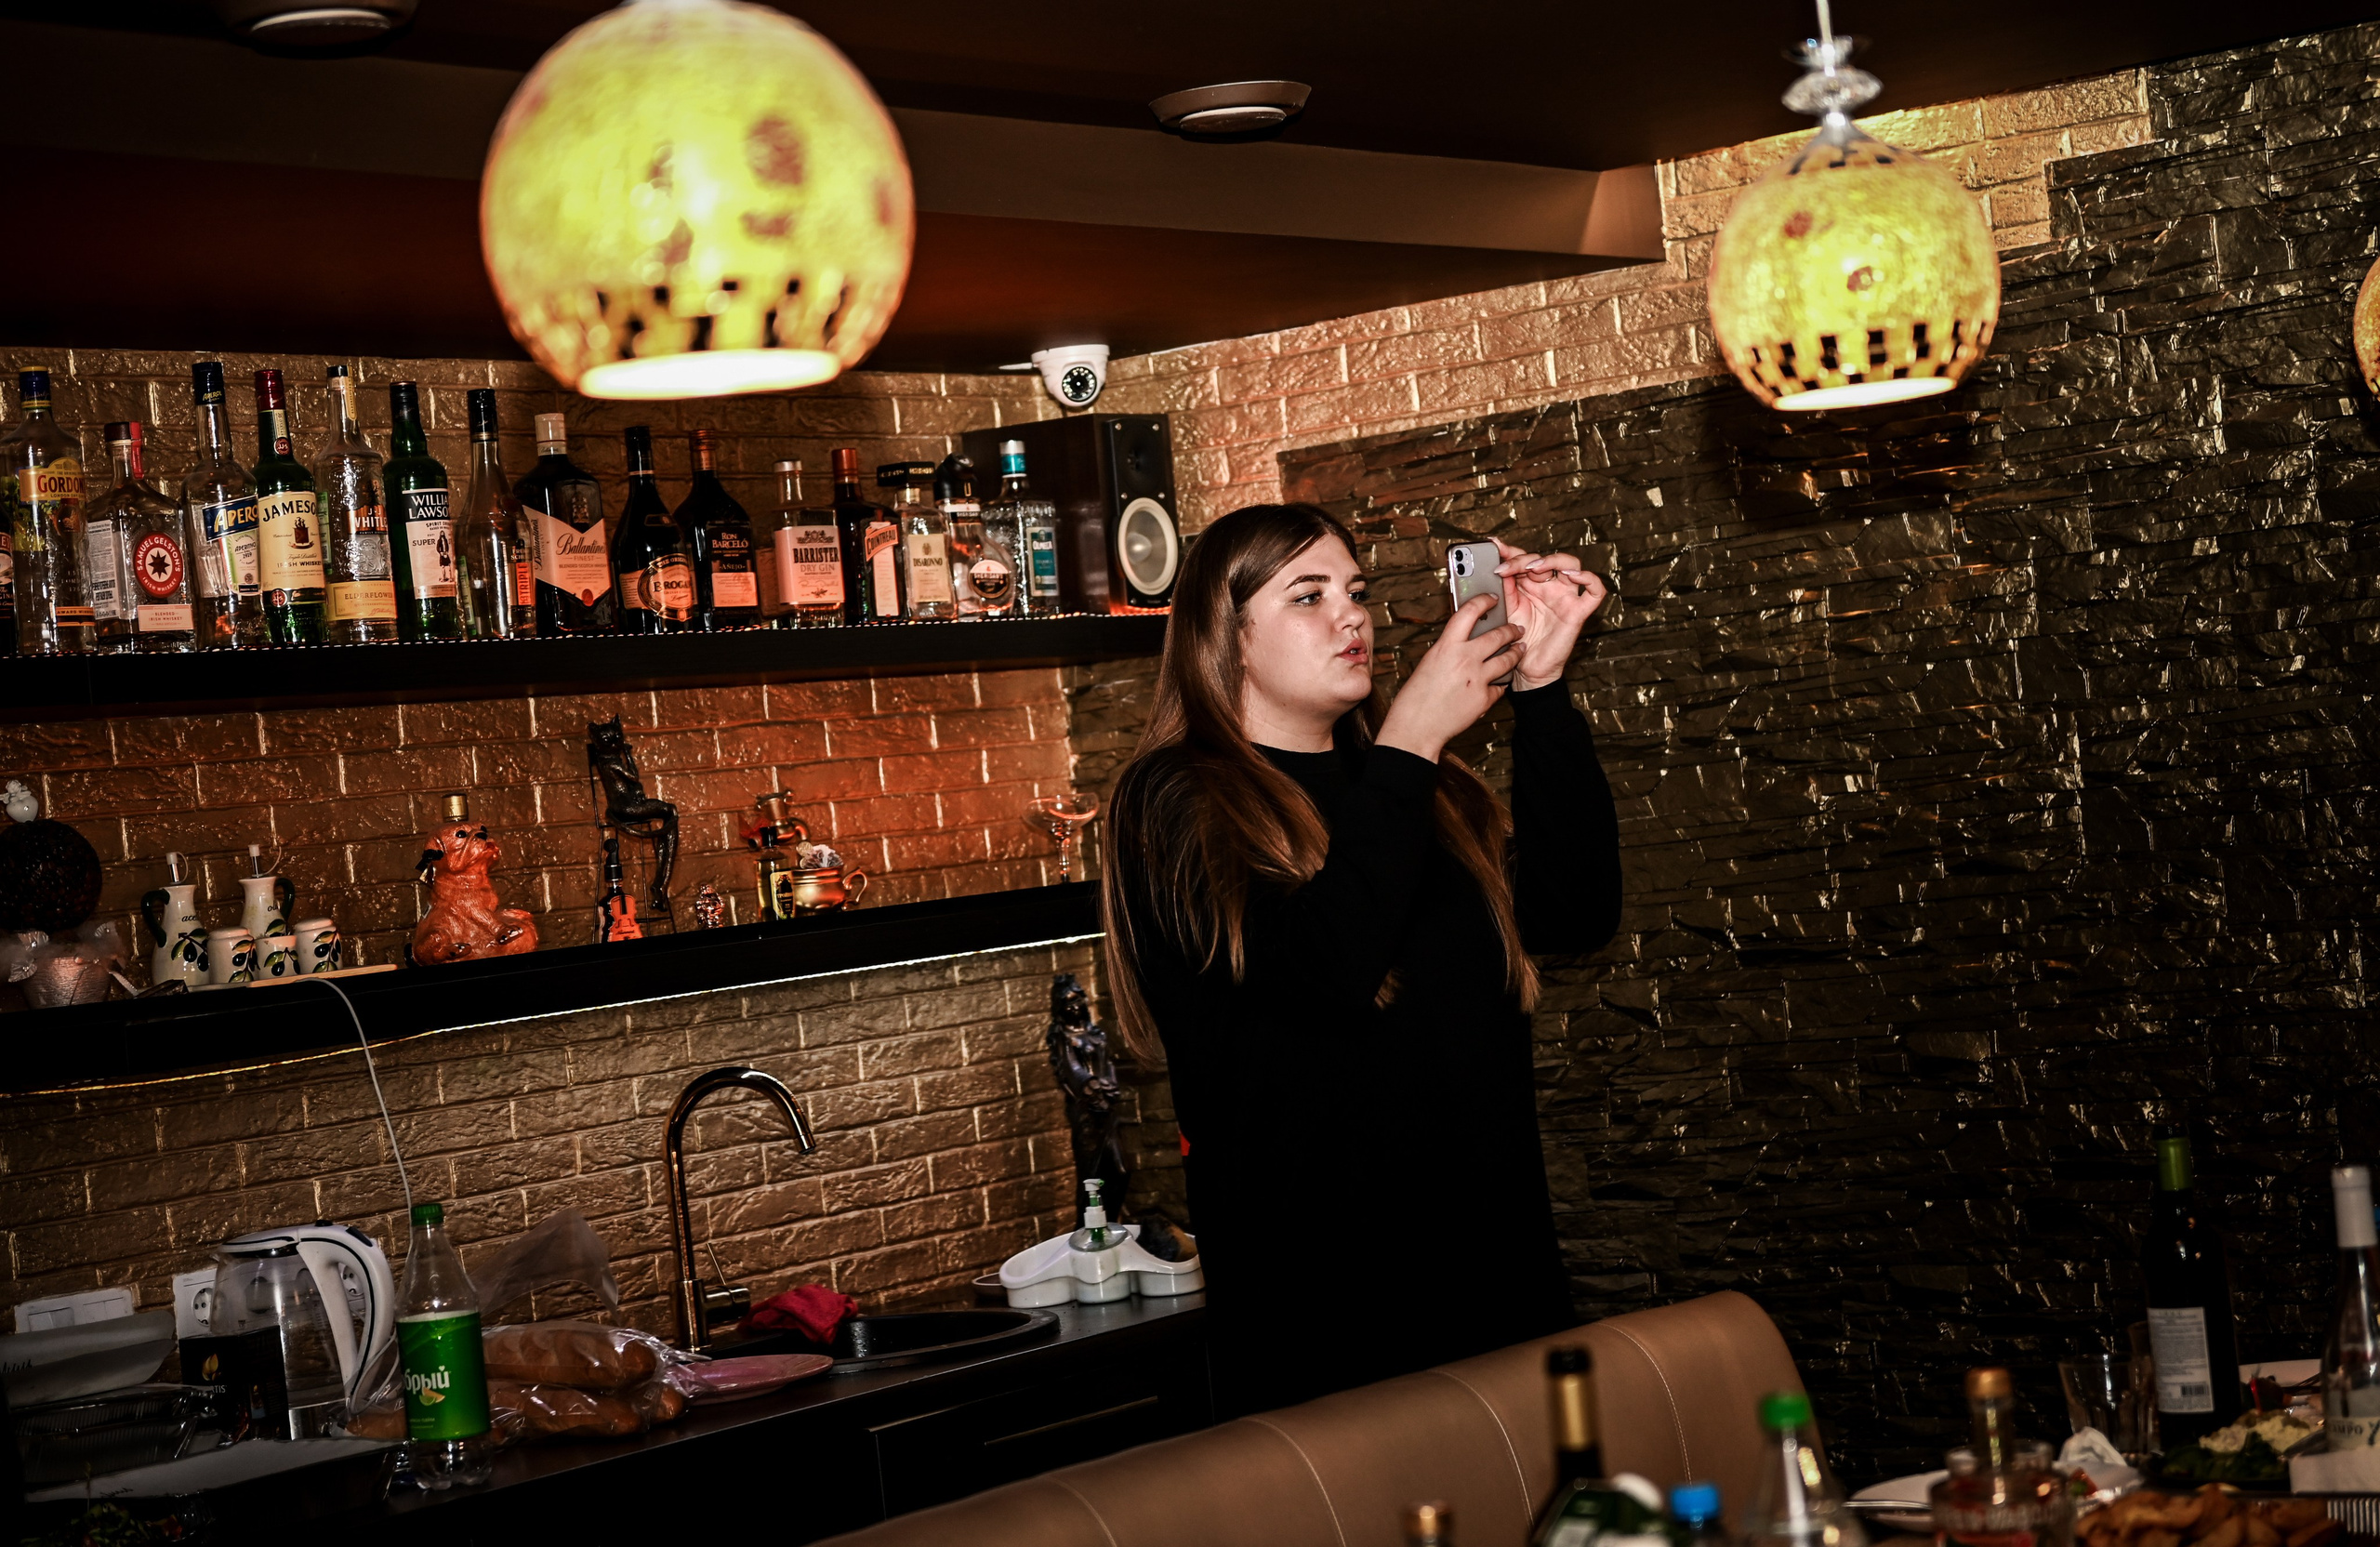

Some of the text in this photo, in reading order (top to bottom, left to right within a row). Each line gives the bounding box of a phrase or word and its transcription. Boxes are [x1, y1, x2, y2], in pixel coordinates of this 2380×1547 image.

[412, 538, 436, 547] SUPER
[711, 538, 749, 549] BARCELÓ
[866, 528, 897, 556] COINTREAU
[137, 536, 180, 572] SAMUEL GELSTON'S
[792, 547, 840, 563] BARRISTER
[800, 563, 835, 573] DRY GIN
